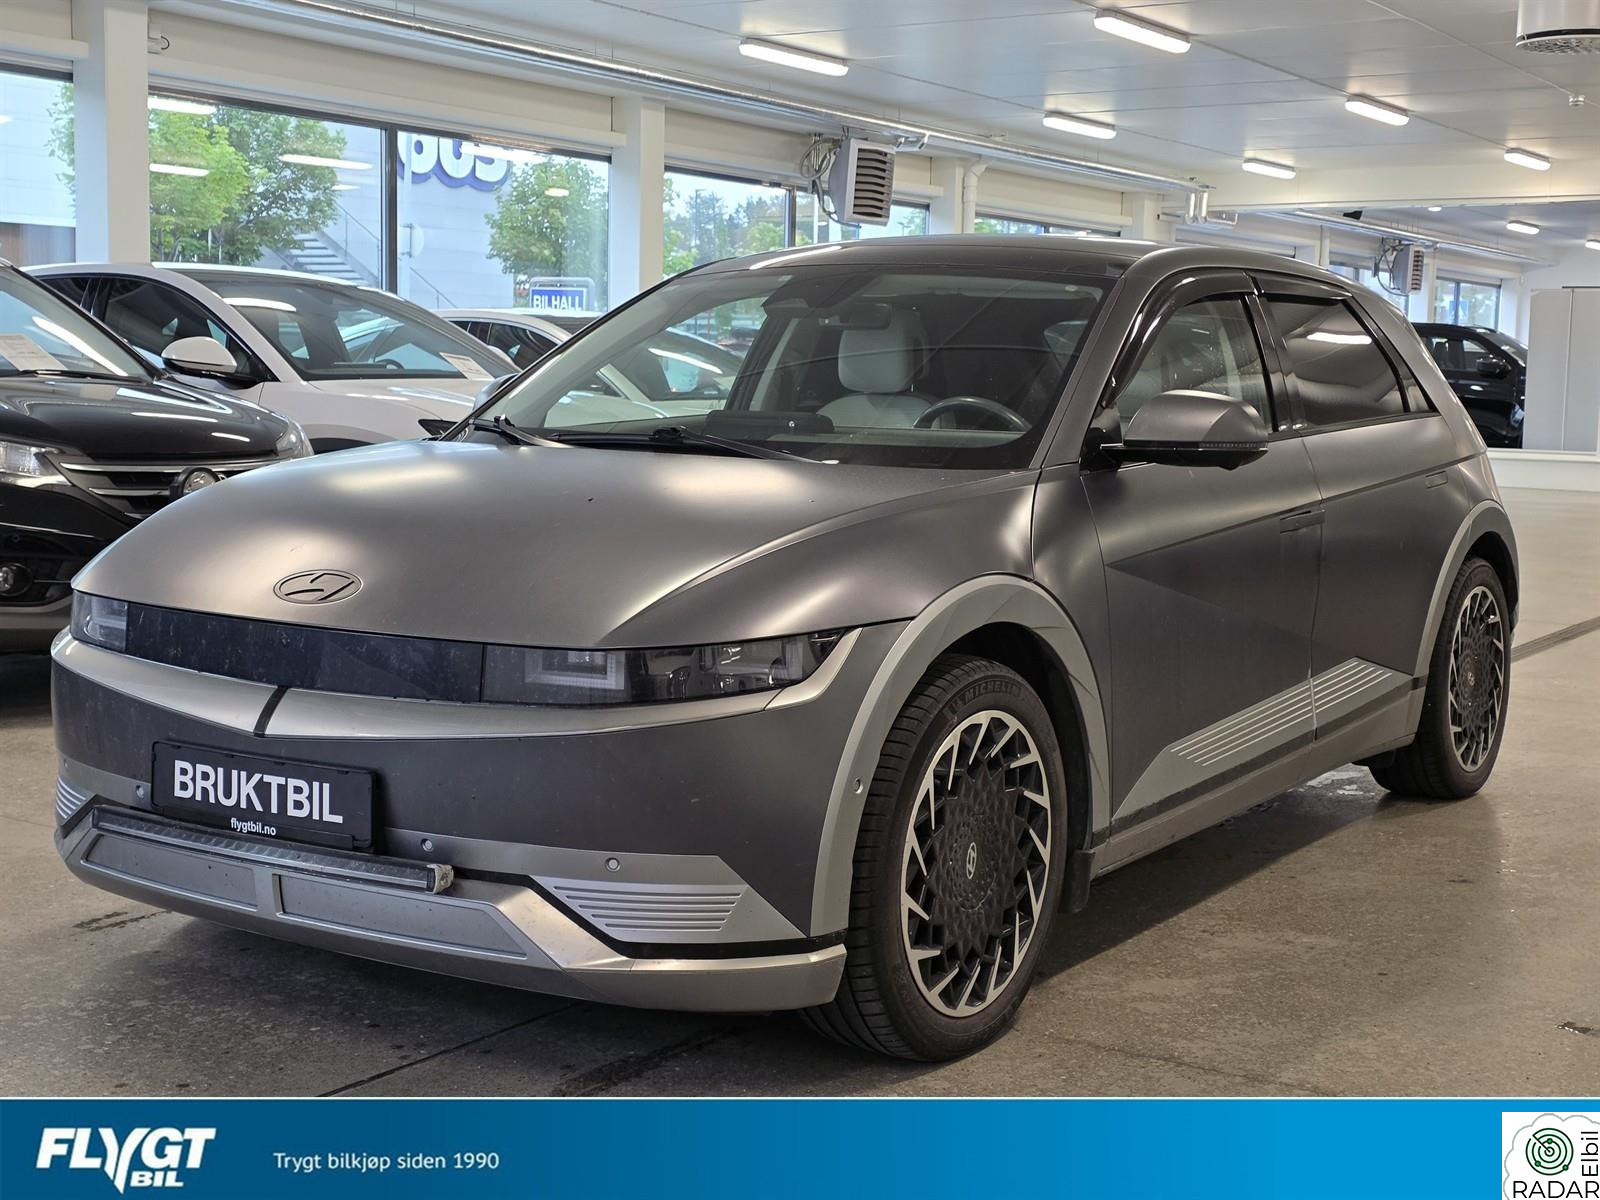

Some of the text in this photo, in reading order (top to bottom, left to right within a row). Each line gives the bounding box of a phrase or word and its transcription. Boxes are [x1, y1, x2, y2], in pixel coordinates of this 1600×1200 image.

[533, 295, 582, 310] BILHALL
[963, 679, 1023, 704] MICHELIN
[173, 759, 344, 824] BRUKTBIL
[230, 817, 276, 836] flygtbil.no
